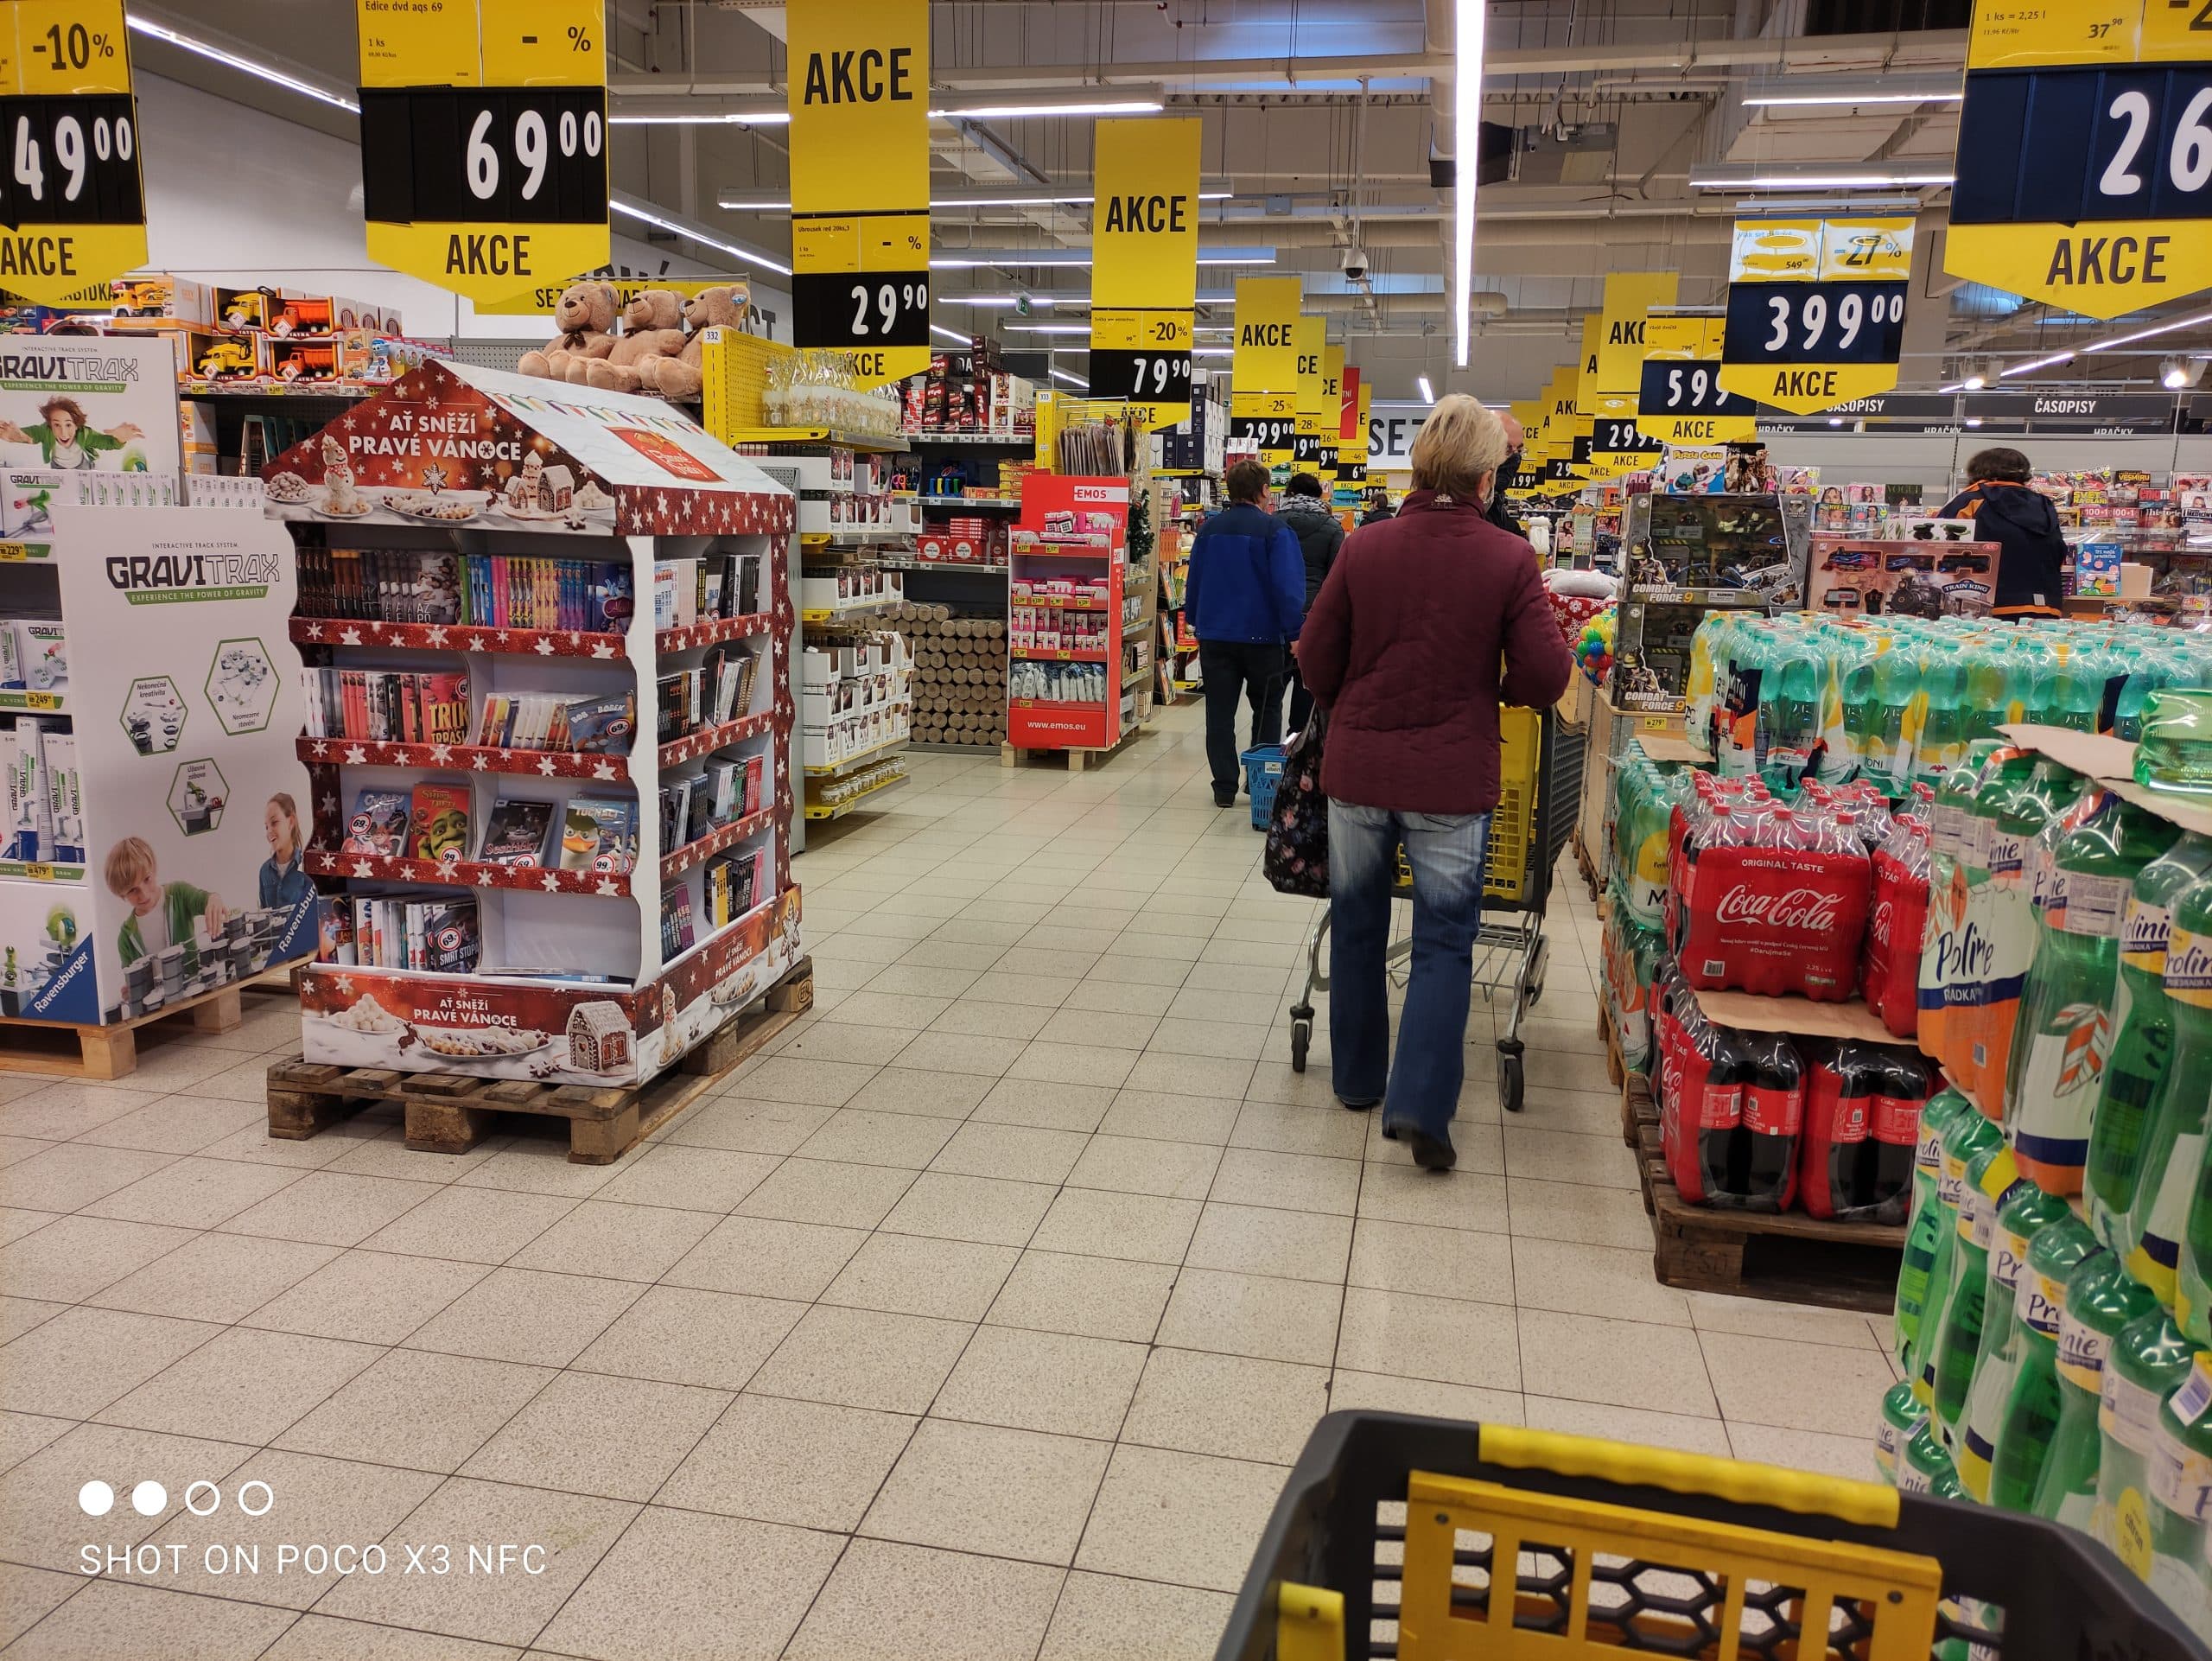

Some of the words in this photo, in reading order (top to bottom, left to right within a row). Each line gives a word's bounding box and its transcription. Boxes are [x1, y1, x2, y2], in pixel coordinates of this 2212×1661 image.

[365, 1, 389, 11] Edice
[391, 0, 409, 11] dvd
[411, 3, 429, 13] aqs
[431, 2, 442, 12] 69
[1994, 12, 2005, 21] ks
[2018, 11, 2039, 21] 2,25
[804, 48, 912, 105] AKCE
[1104, 195, 1186, 233] AKCE
[1, 236, 77, 277] AKCE
[445, 233, 531, 277] AKCE
[2044, 234, 2171, 286] AKCE
[707, 332, 719, 340] 332
[1241, 323, 1293, 347] AKCE
[0, 354, 139, 382] RAVITRAX
[849, 353, 885, 376] KCE
[1298, 355, 1319, 374] CE
[1772, 371, 1838, 397] AKCE
[2034, 398, 2097, 414] ČASOPISY
[389, 410, 414, 432] AŤ
[417, 410, 476, 434] SNĚŽÍ
[1672, 420, 1715, 438] AKCE
[348, 430, 421, 457] PRAVÉ
[424, 435, 521, 461] VÁNOCE
[1261, 452, 1273, 463] CE
[1612, 455, 1639, 467] AKCE
[1700, 451, 1724, 460] GAME
[1588, 467, 1611, 476] AKCE
[1558, 480, 1575, 489] AKCE
[1075, 488, 1107, 499] EMOS
[2085, 508, 2108, 517] 100+1
[105, 553, 281, 589] GRAVITRAX
[131, 592, 178, 602] EXPERIENCE
[180, 591, 194, 601] THE
[196, 590, 222, 599] POWER
[224, 589, 233, 598] OF
[235, 588, 265, 597] GRAVITY
[1632, 583, 1674, 594] COMBAT
[1944, 582, 1967, 592] TRAIN
[1967, 583, 1989, 593] KING
[1649, 593, 1683, 603] FORCE
[1684, 592, 1694, 603] 9
[1624, 691, 1667, 702] COMBAT
[1642, 701, 1675, 711] FORCE
[1675, 700, 1685, 711] 9
[1027, 720, 1086, 731] www.emos.eu
[1741, 858, 1788, 870] ORIGINAL
[1790, 861, 1825, 874] TASTE
[1715, 883, 1846, 931] Coca-Cola
[278, 882, 317, 954] Ravensbur
[34, 951, 90, 1014] Ravensburger
[439, 997, 454, 1009] AŤ
[455, 997, 490, 1010] SNĚŽÍ
[413, 1006, 458, 1023] PRAVÉ
[460, 1010, 518, 1028] VÁNOCE
